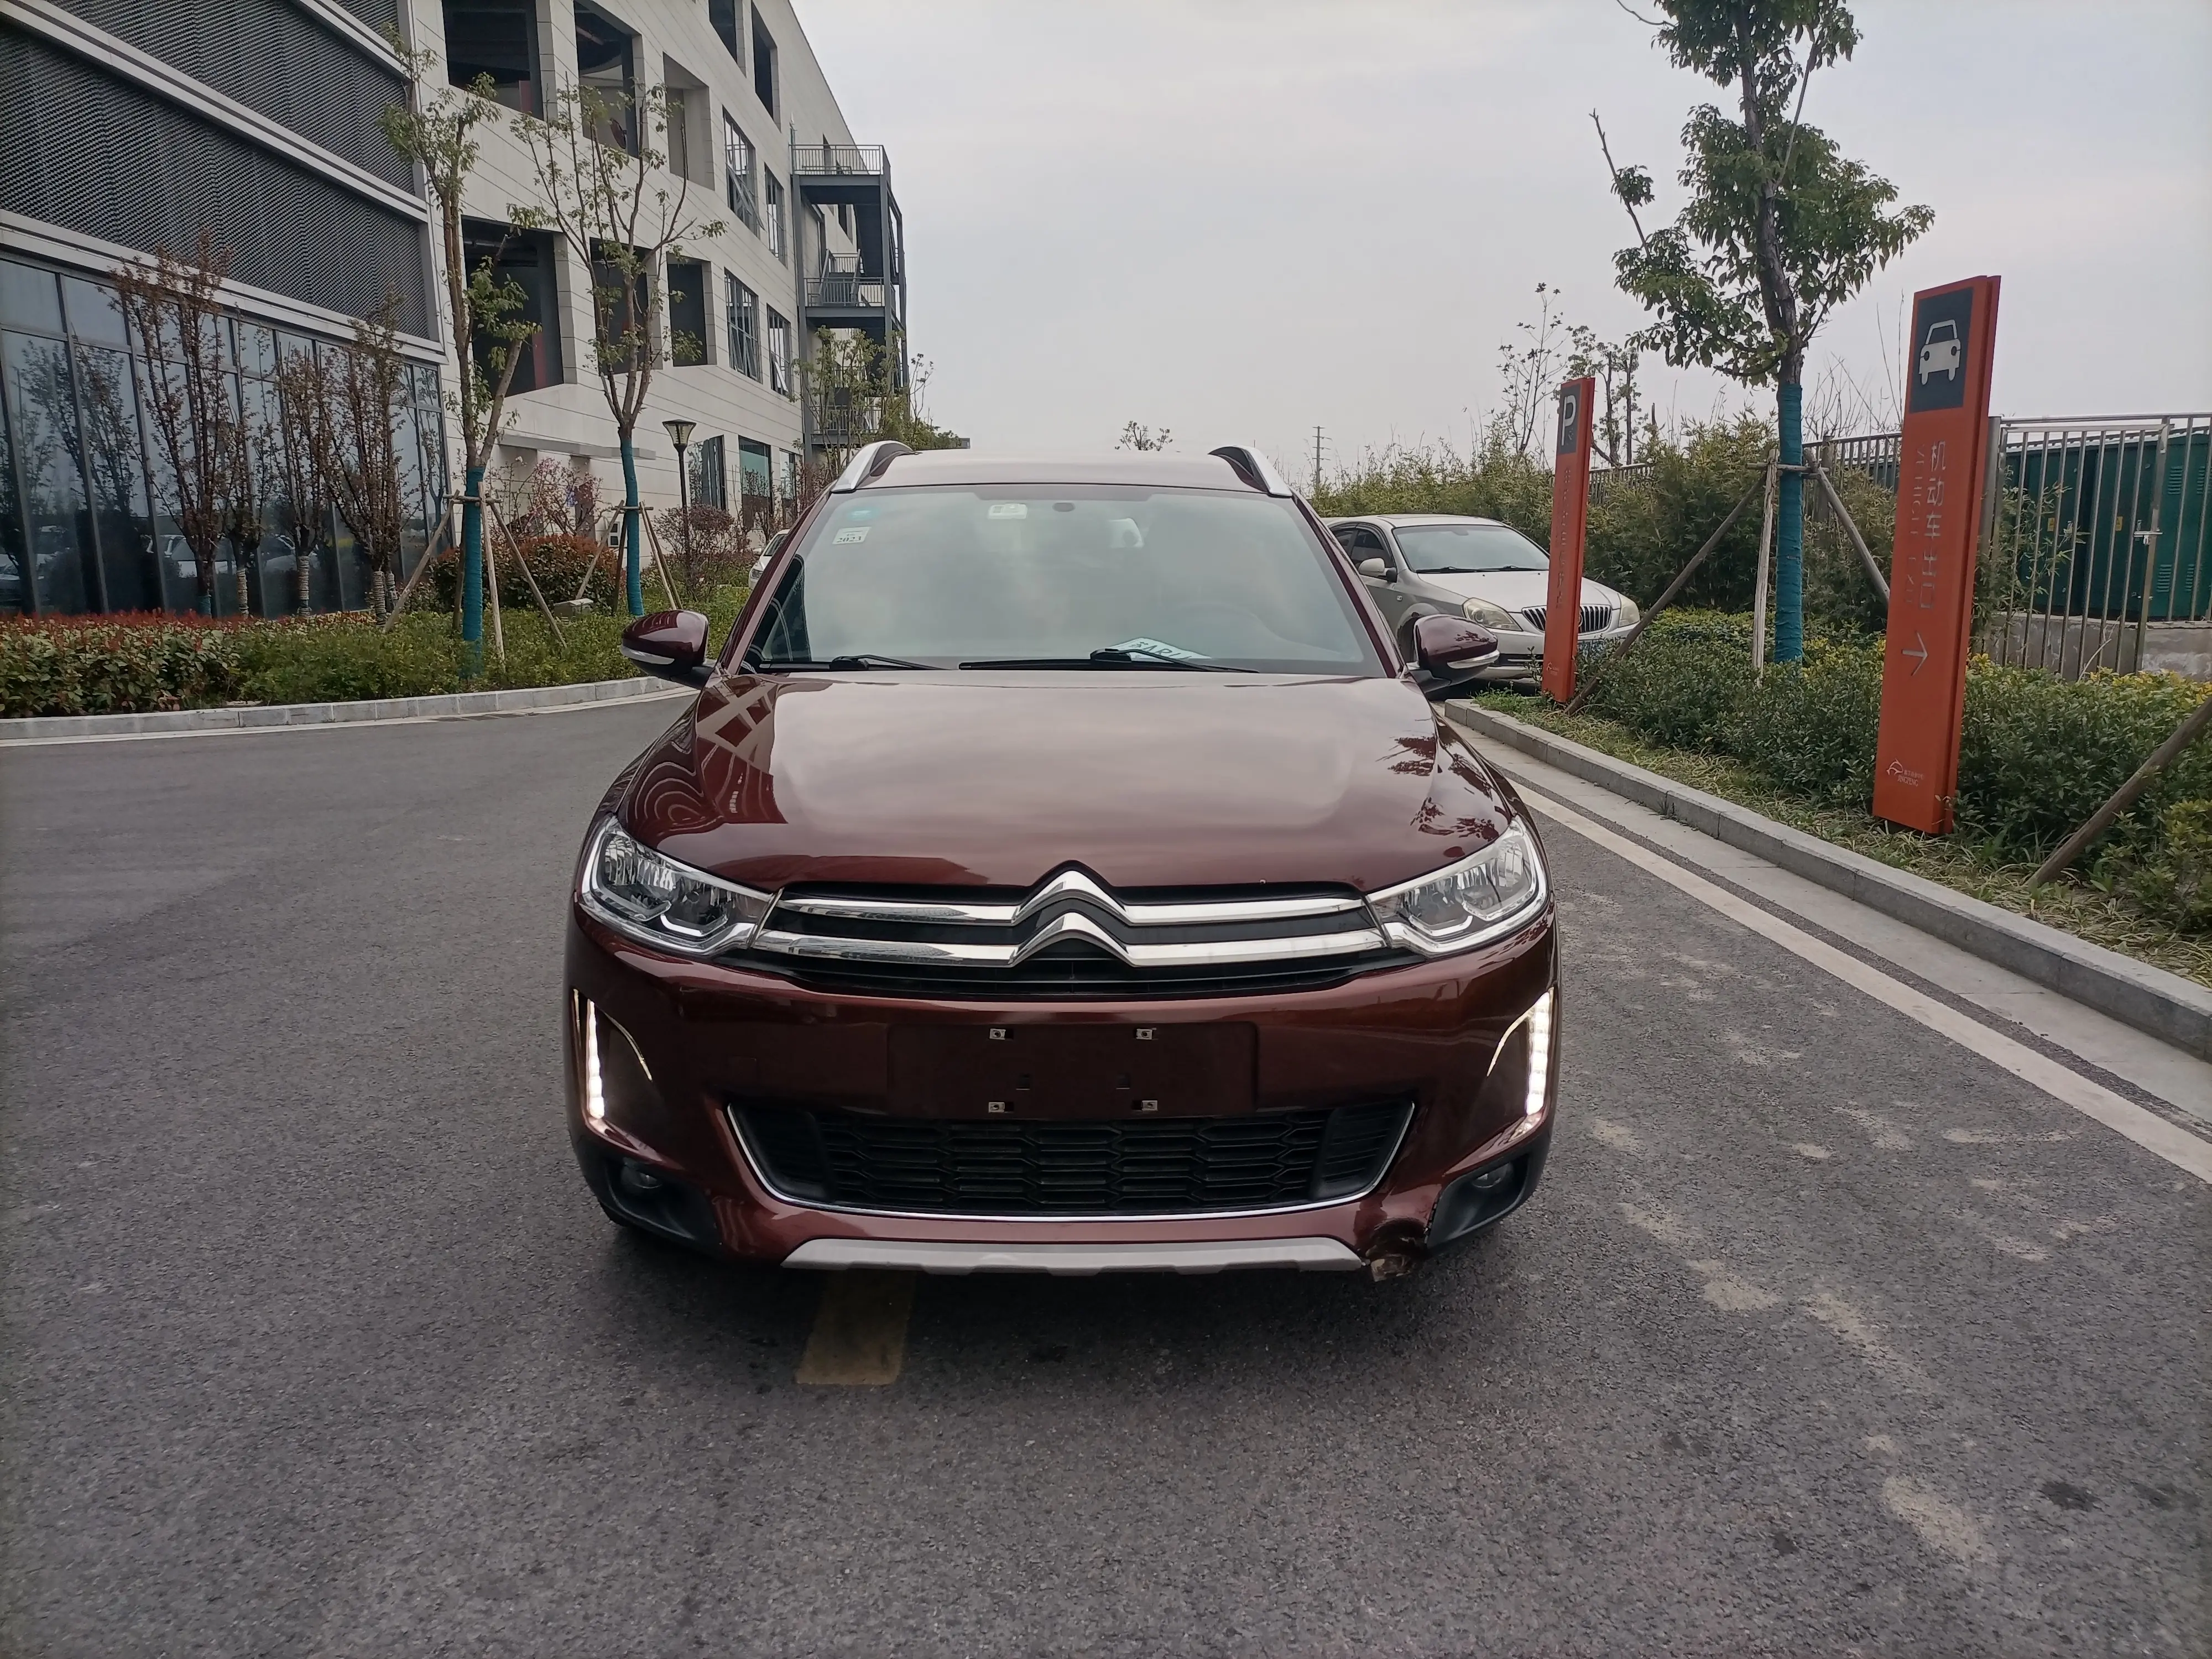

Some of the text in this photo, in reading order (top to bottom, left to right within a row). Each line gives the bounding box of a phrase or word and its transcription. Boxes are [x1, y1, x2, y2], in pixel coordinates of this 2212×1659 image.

[1561, 395, 1576, 446] P
[1919, 441, 1946, 609] 机动车出口
